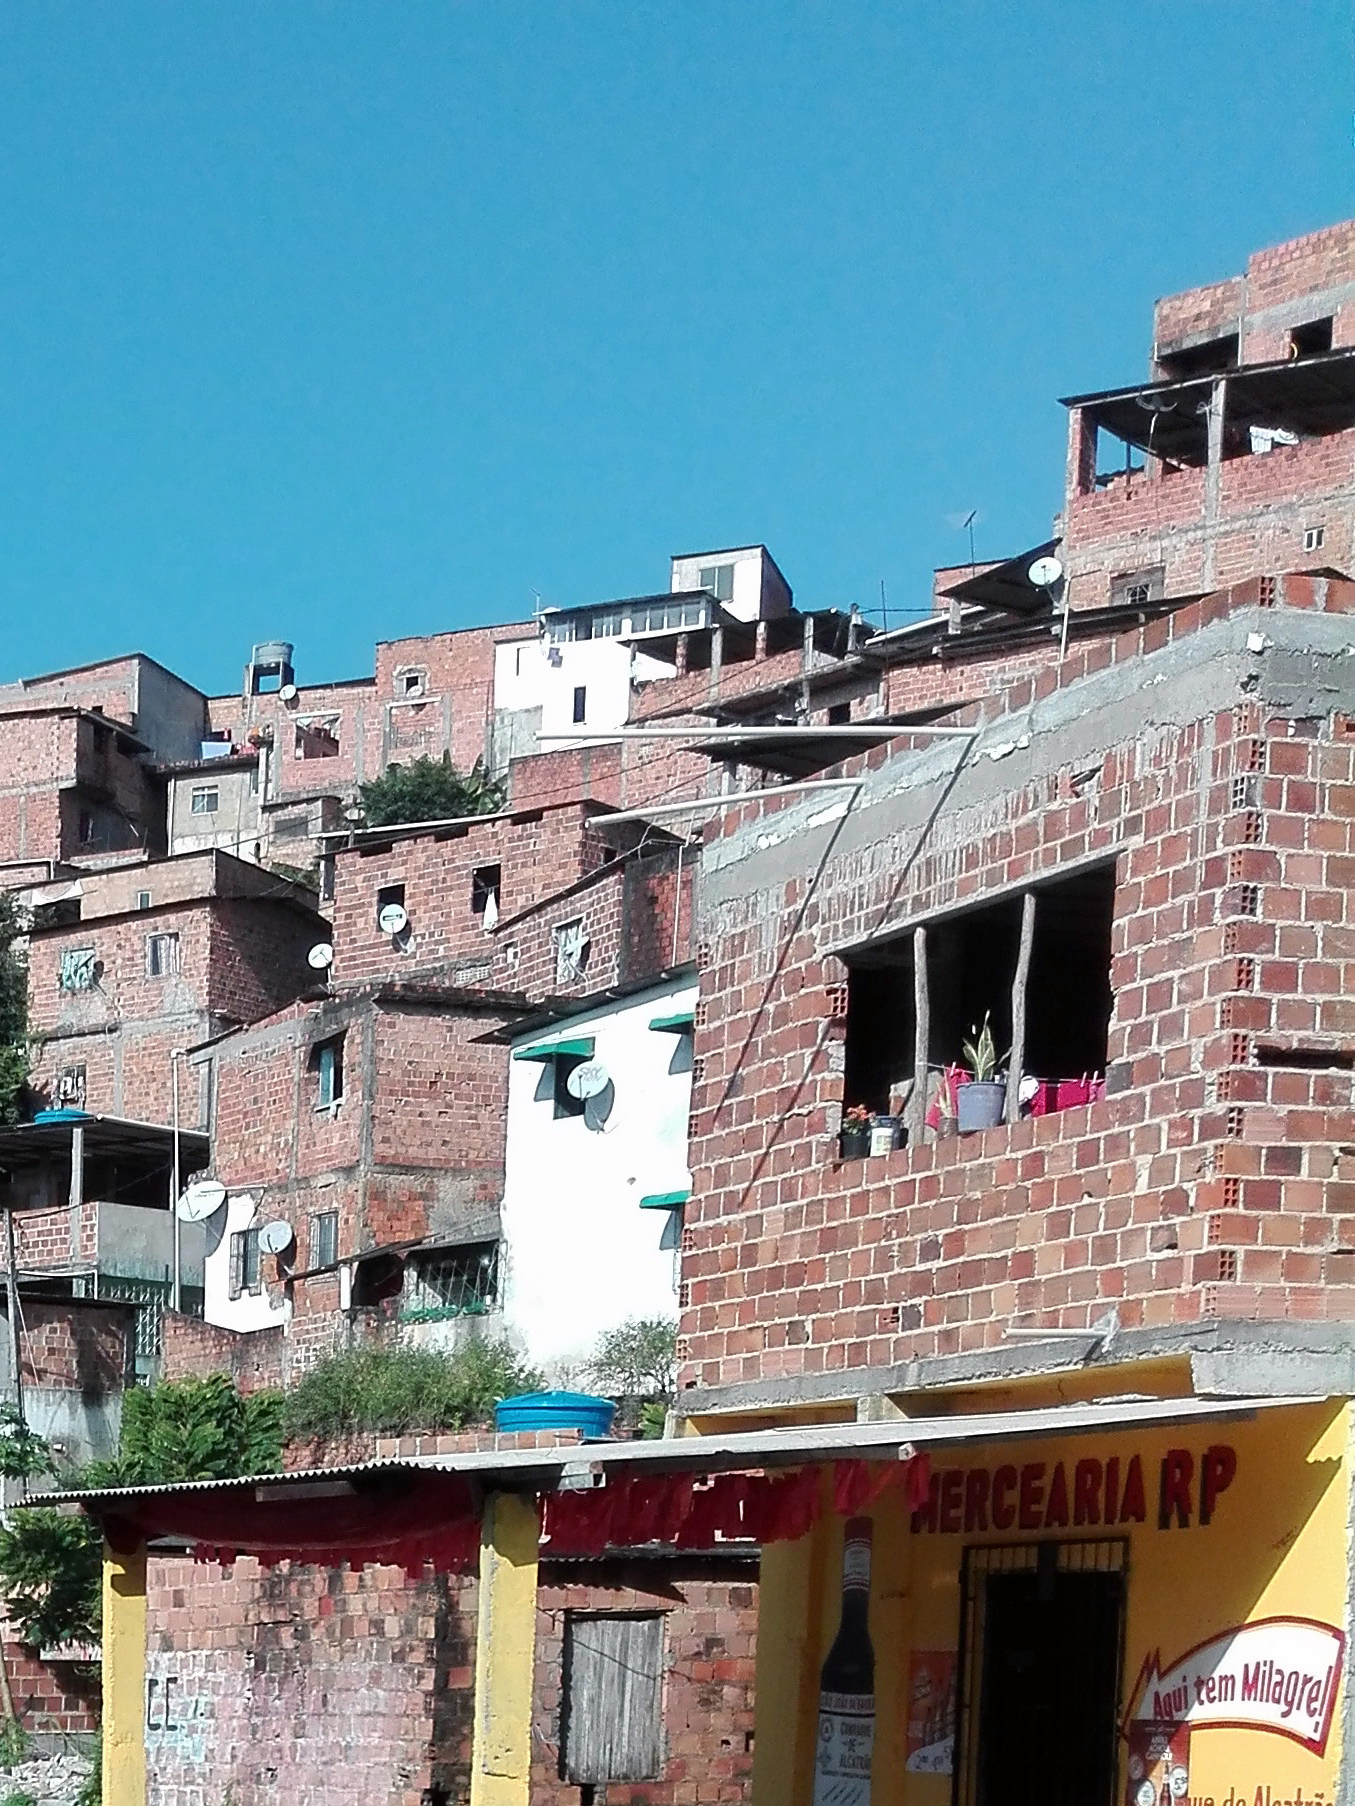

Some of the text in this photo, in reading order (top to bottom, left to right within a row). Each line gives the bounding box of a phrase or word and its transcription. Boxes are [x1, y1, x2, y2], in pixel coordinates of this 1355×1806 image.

[910, 1455, 1147, 1534] MERCEARIA
[1153, 1675, 1189, 1721] Aqui
[1195, 1674, 1236, 1706] tem
